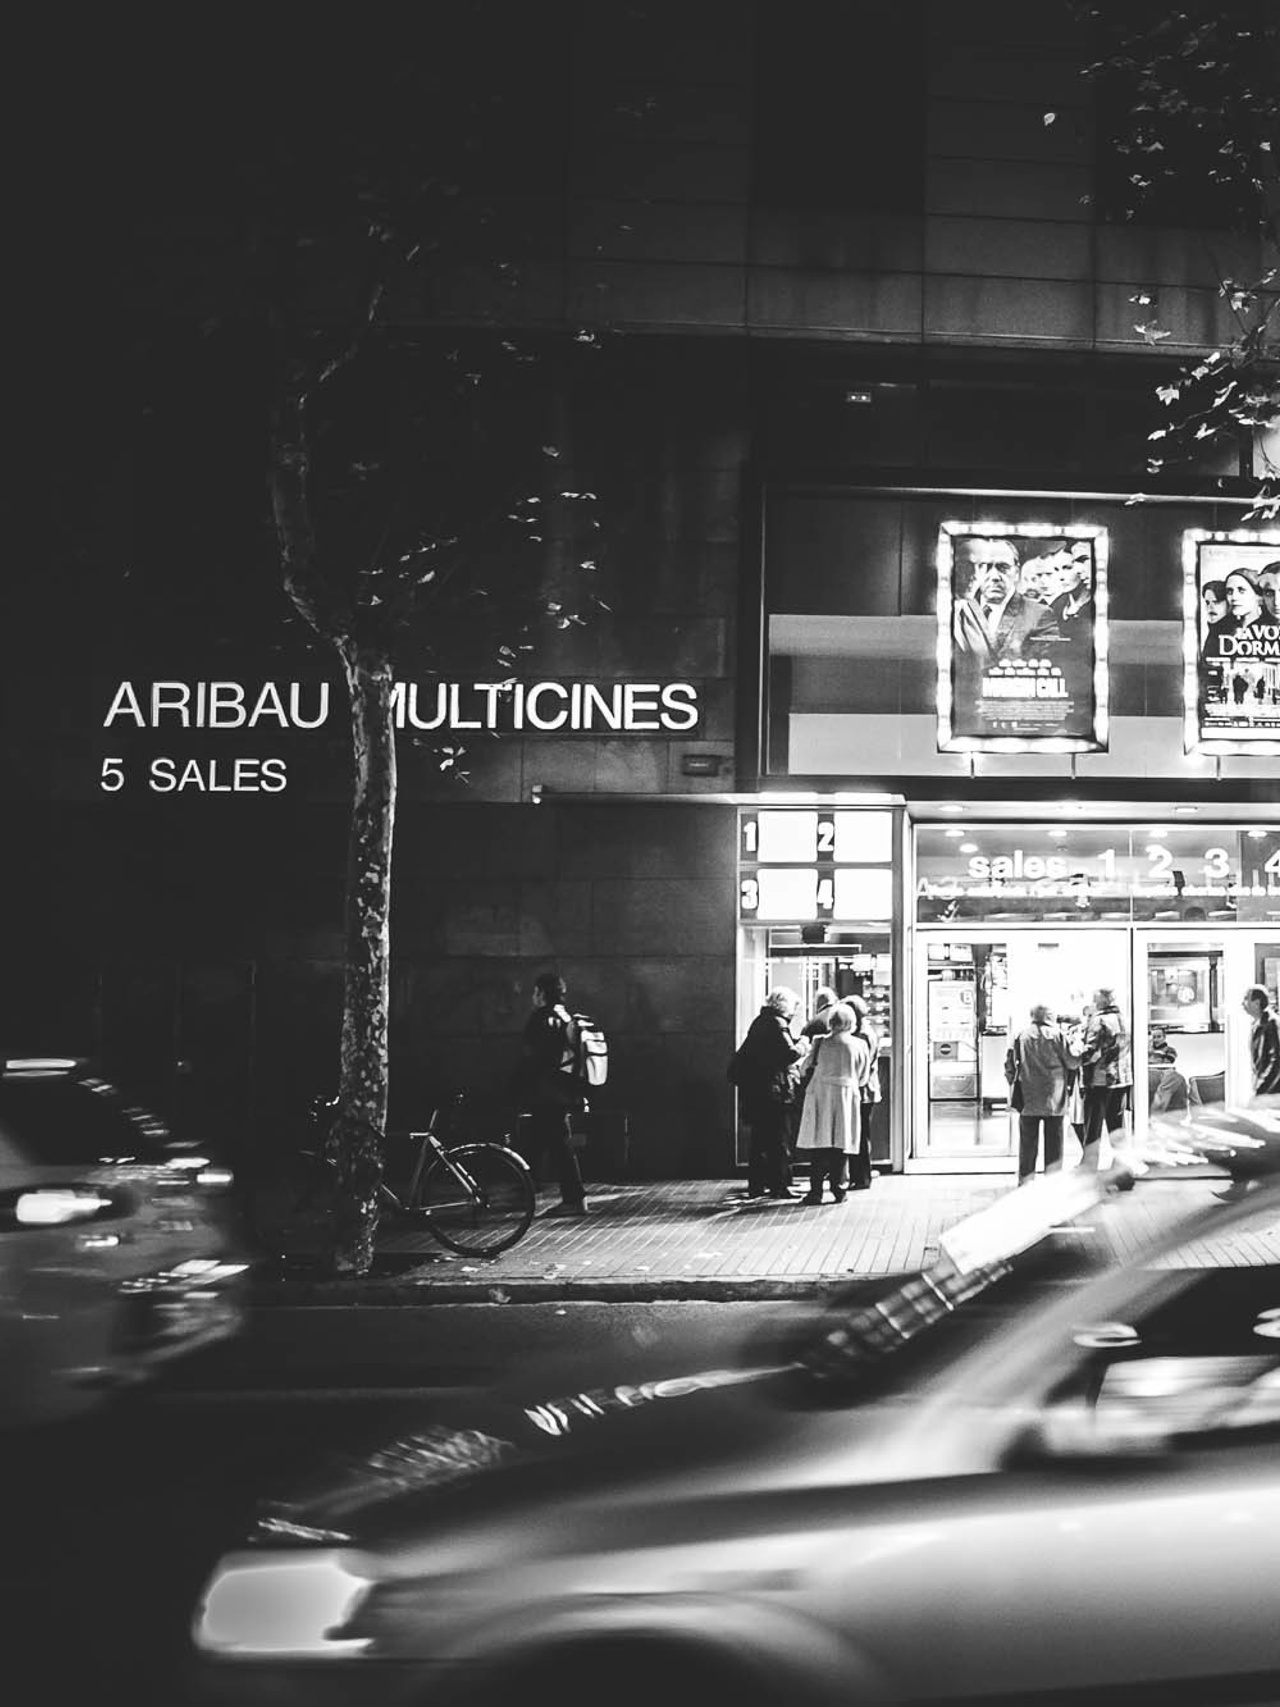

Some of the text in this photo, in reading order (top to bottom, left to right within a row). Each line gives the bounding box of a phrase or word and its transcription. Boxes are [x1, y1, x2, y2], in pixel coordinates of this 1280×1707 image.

[103, 681, 330, 729] ARIBAU
[101, 758, 287, 793] 5 SALES
[743, 821, 834, 852] 1 2
[968, 849, 1068, 879] sales
[1098, 849, 1115, 878] 1
[1146, 844, 1174, 879] 2
[1204, 848, 1230, 878] 3
[740, 878, 834, 910] 3 4
